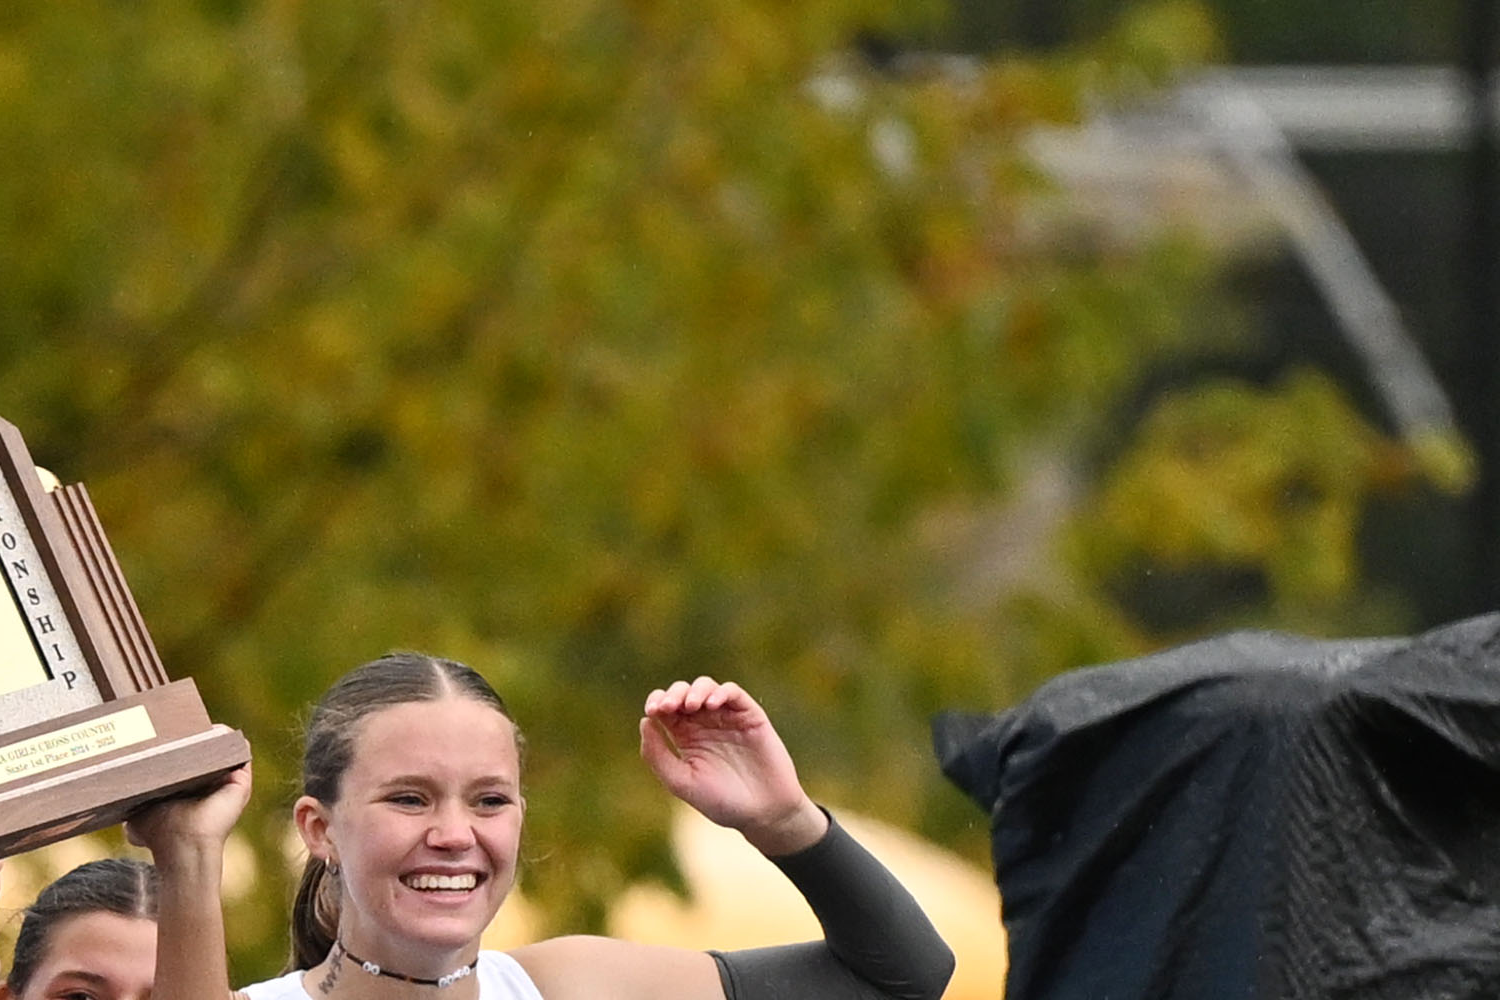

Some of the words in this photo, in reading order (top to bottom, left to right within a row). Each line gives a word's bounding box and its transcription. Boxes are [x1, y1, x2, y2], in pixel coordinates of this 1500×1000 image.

[7, 745, 38, 761] GIRLS
[38, 734, 70, 752] CROSS
[71, 721, 116, 741] COUNTRY
[5, 762, 29, 775] State
[44, 751, 69, 764] Place
